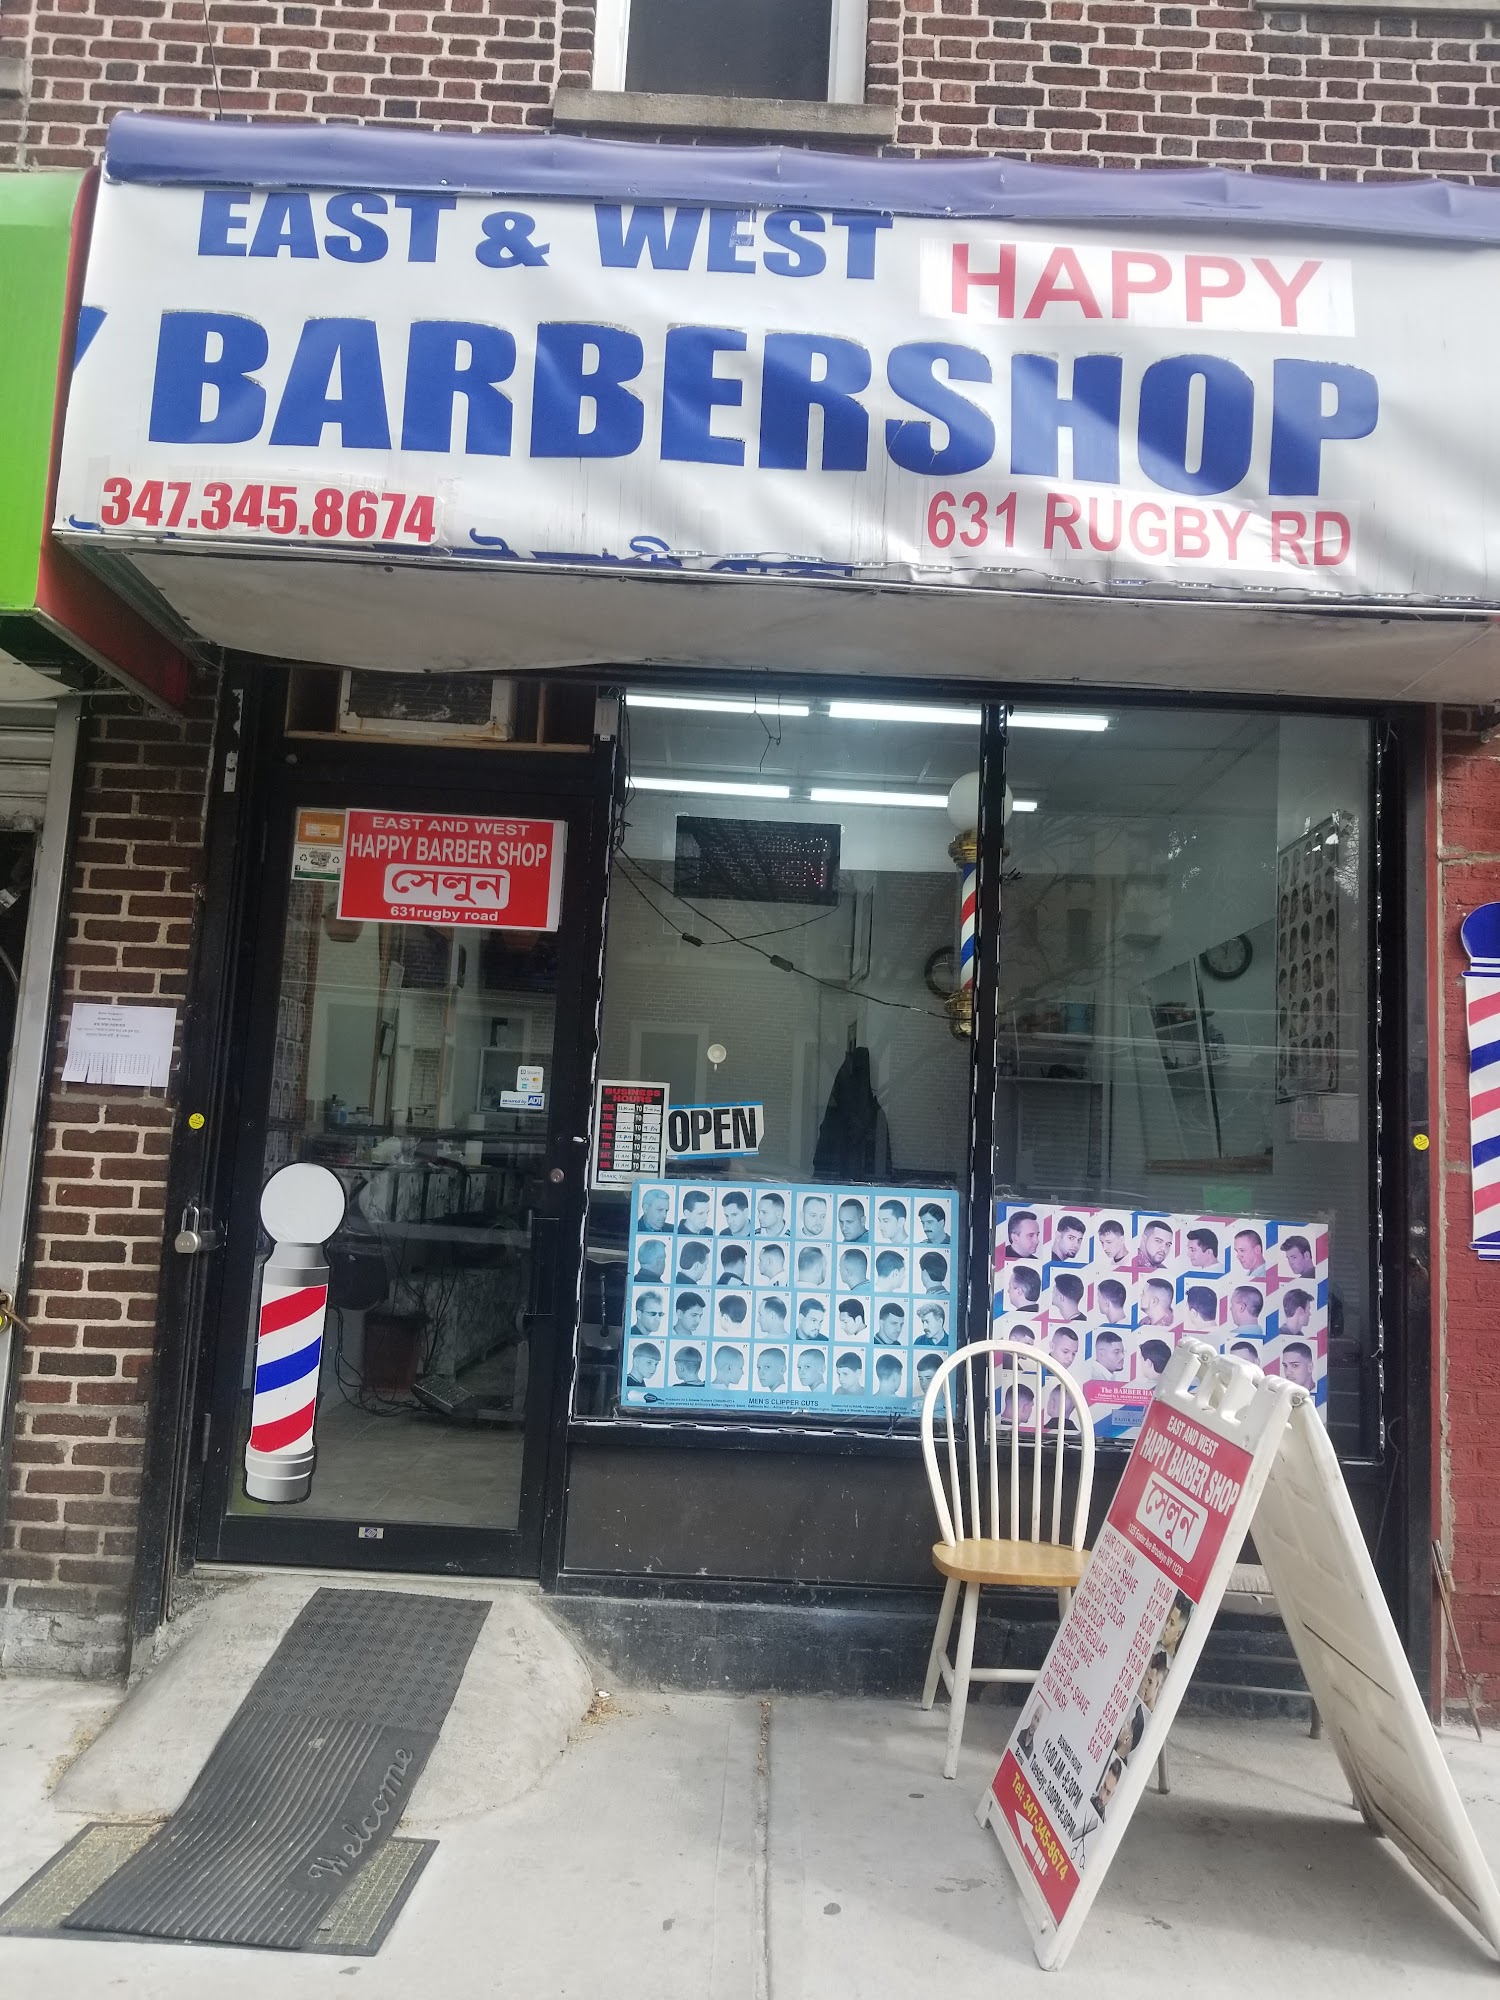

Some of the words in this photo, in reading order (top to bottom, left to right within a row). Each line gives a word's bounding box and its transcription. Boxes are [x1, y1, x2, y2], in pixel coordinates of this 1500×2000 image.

[198, 190, 457, 263] EAST
[476, 211, 549, 268] &
[593, 200, 893, 279] WEST
[950, 242, 1323, 326] HAPPY
[148, 311, 1379, 496] BARBERSHOP
[101, 477, 436, 543] 347.345.8674
[927, 490, 1018, 549] 631
[1044, 492, 1252, 562] RUGBY
[1272, 509, 1351, 566] RD
[350, 833, 412, 860] HAPPY
[416, 837, 491, 864] BARBER
[496, 842, 548, 867] SHOP
[372, 816, 423, 830] EAST
[428, 820, 469, 832] AND
[474, 822, 530, 836] WEST
[392, 870, 506, 905] সেলুন
[464, 911, 498, 922] road
[528, 1096, 542, 1105] ADT
[605, 1088, 661, 1097] BUSINESS
[612, 1095, 652, 1103] HOURS
[668, 1108, 757, 1152] OPEN
[1140, 1428, 1174, 1470] HAPPY
[1167, 1446, 1210, 1497] BARBER
[1204, 1470, 1240, 1515] SHOP
[1166, 1415, 1186, 1437] EAST
[1182, 1426, 1199, 1446] AND
[1196, 1433, 1219, 1458] WEST
[1146, 1480, 1198, 1546] সেলুন
[1089, 1560, 1103, 1580] HAIR
[1101, 1572, 1113, 1588] CUT
[1110, 1581, 1126, 1605] CHILD
[1139, 1612, 1155, 1636] $8.00
[1096, 1545, 1110, 1560] HAIR
[1107, 1556, 1120, 1574] CUT
[1120, 1568, 1138, 1594] SHAVE
[1146, 1595, 1165, 1622] $17.00
[1104, 1532, 1116, 1548] HAIR
[1113, 1540, 1126, 1556] CUT
[1123, 1549, 1136, 1569] MAN
[1153, 1578, 1172, 1603] $10.00
[1165, 1556, 1173, 1567] NY
[1070, 1606, 1087, 1633] SHAVE
[1085, 1624, 1107, 1657] REGULAR
[1118, 1666, 1134, 1690] $7.00
[1076, 1592, 1090, 1610] HAIR
[1087, 1604, 1105, 1629] COLOR
[1126, 1648, 1143, 1676] $15.00
[1083, 1578, 1096, 1597] HAIR
[1094, 1588, 1106, 1605] CUT
[1107, 1602, 1125, 1628] COLOR
[1132, 1630, 1150, 1658] $25.00
[1049, 1655, 1066, 1682] SHAPE
[1063, 1674, 1072, 1687] UP
[1072, 1686, 1090, 1716] SHAVE
[1095, 1718, 1112, 1748] $12.00
[1056, 1639, 1073, 1666] SHAPE
[1070, 1657, 1079, 1672] UP
[1102, 1700, 1118, 1726] $5.00
[1063, 1623, 1079, 1648] FANCY
[1076, 1640, 1094, 1668] SHAVE
[1110, 1683, 1128, 1712] $10.00
[1043, 1671, 1057, 1692] ONLY
[1052, 1685, 1068, 1710] WASH
[1087, 1736, 1102, 1763] $5.00
[1057, 1734, 1073, 1760] BUSINESS
[1071, 1755, 1082, 1775] HOURS
[1042, 1738, 1057, 1767] 11:00
[1052, 1757, 1065, 1780] AM
[308, 1748, 414, 1878] Welcome
[1012, 1772, 1024, 1801] Tel:
[1023, 1794, 1068, 1880] 347-345-8674
